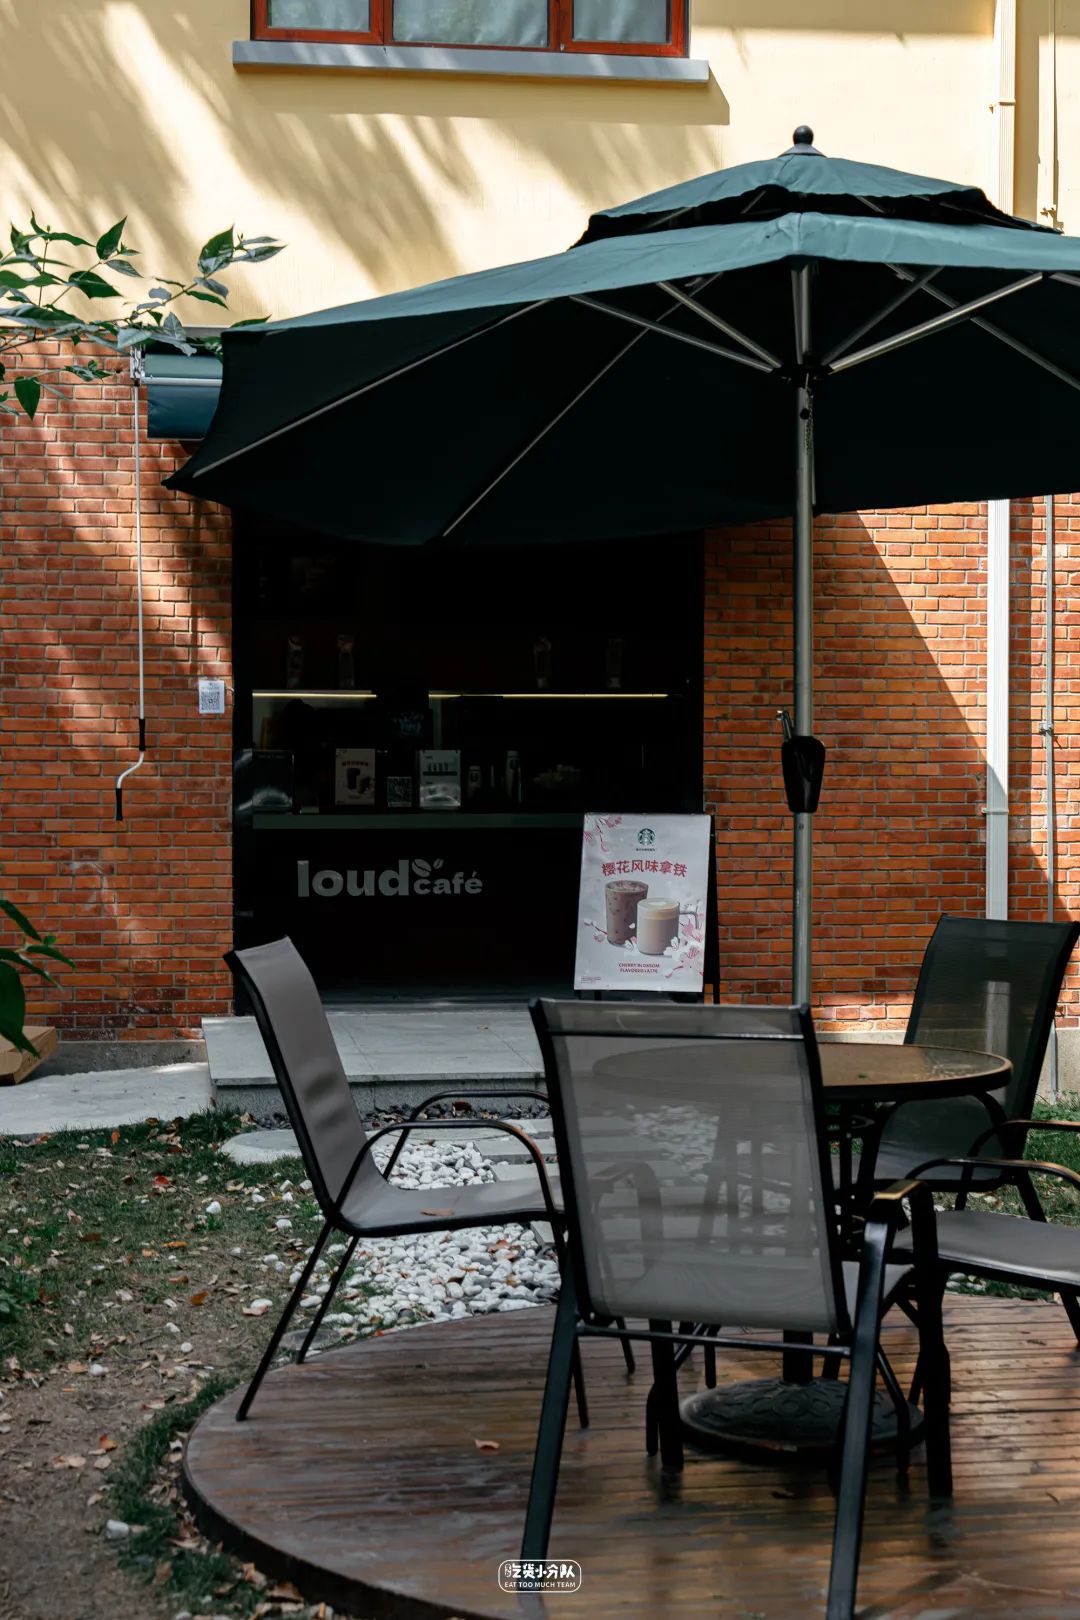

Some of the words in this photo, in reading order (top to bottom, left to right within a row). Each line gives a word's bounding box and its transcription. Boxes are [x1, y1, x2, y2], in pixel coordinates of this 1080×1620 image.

[297, 859, 409, 897] loud
[413, 871, 483, 895] café
[602, 860, 687, 877] 樱花风味拿铁
